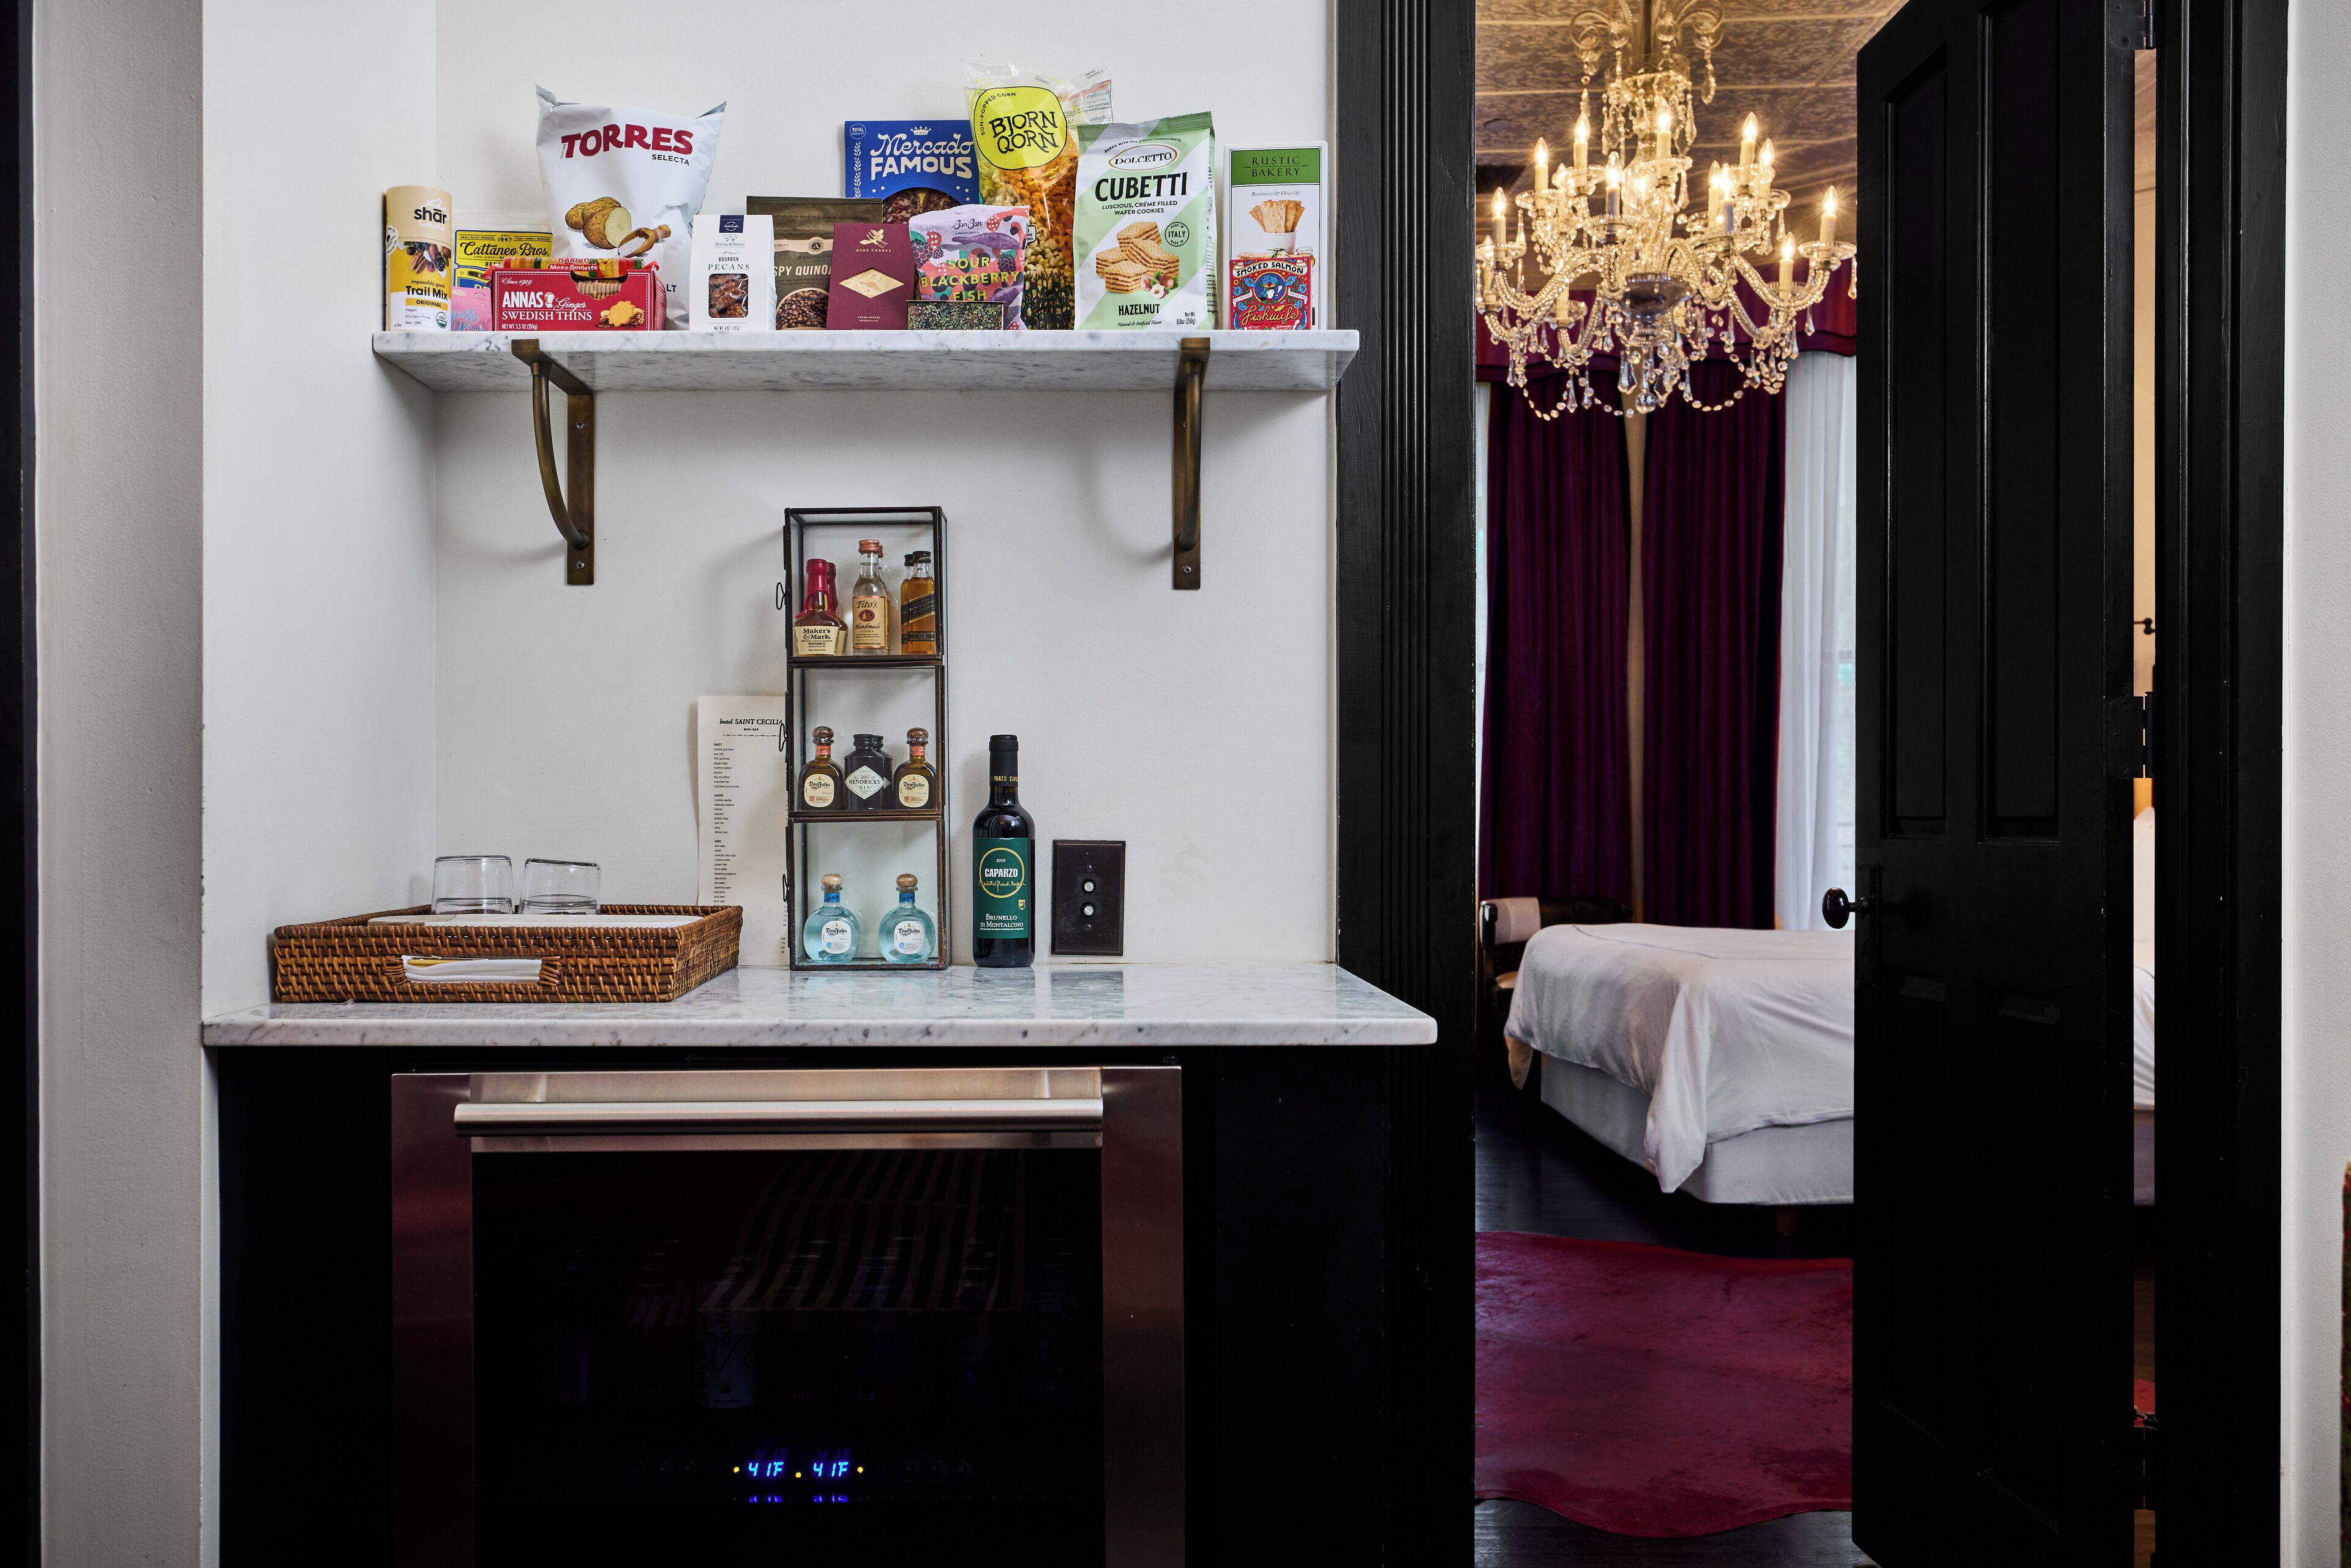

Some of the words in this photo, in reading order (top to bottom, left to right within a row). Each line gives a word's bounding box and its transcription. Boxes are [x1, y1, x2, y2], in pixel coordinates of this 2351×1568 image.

[981, 95, 996, 135] SUN-POPPED
[989, 111, 1058, 138] BJORN
[561, 124, 694, 158] TORRES
[870, 133, 974, 156] Mercado
[997, 130, 1059, 154] QORN
[1104, 144, 1117, 153] BAKED
[652, 154, 689, 166] SELECTA
[1252, 156, 1300, 165] RUSTIC
[871, 157, 972, 181] FAMOUS
[1252, 167, 1300, 177] BAKERY
[1095, 172, 1187, 201] CUBETTI
[460, 242, 518, 255] Cattaneo
[519, 242, 549, 256] Bros.
[795, 264, 831, 276] QUINO
[948, 257, 990, 269] SOUR
[1237, 262, 1269, 276] SMOKED
[1272, 262, 1303, 274] SALMON
[921, 271, 1019, 287] BLACKBERRY
[406, 286, 430, 296] Trail
[432, 288, 448, 301] Mix
[953, 290, 987, 301] FISH
[502, 291, 543, 308] ANNAS
[553, 297, 587, 312] Ginger
[502, 311, 553, 320] SWEDISH
[556, 311, 592, 321] THINS
[1119, 304, 1160, 316] HAZELNUT
[1242, 305, 1299, 325] Fishwife
[984, 868, 1018, 877] CAPARZO
[748, 1461, 784, 1477] 41F
[813, 1461, 849, 1477] 41F
